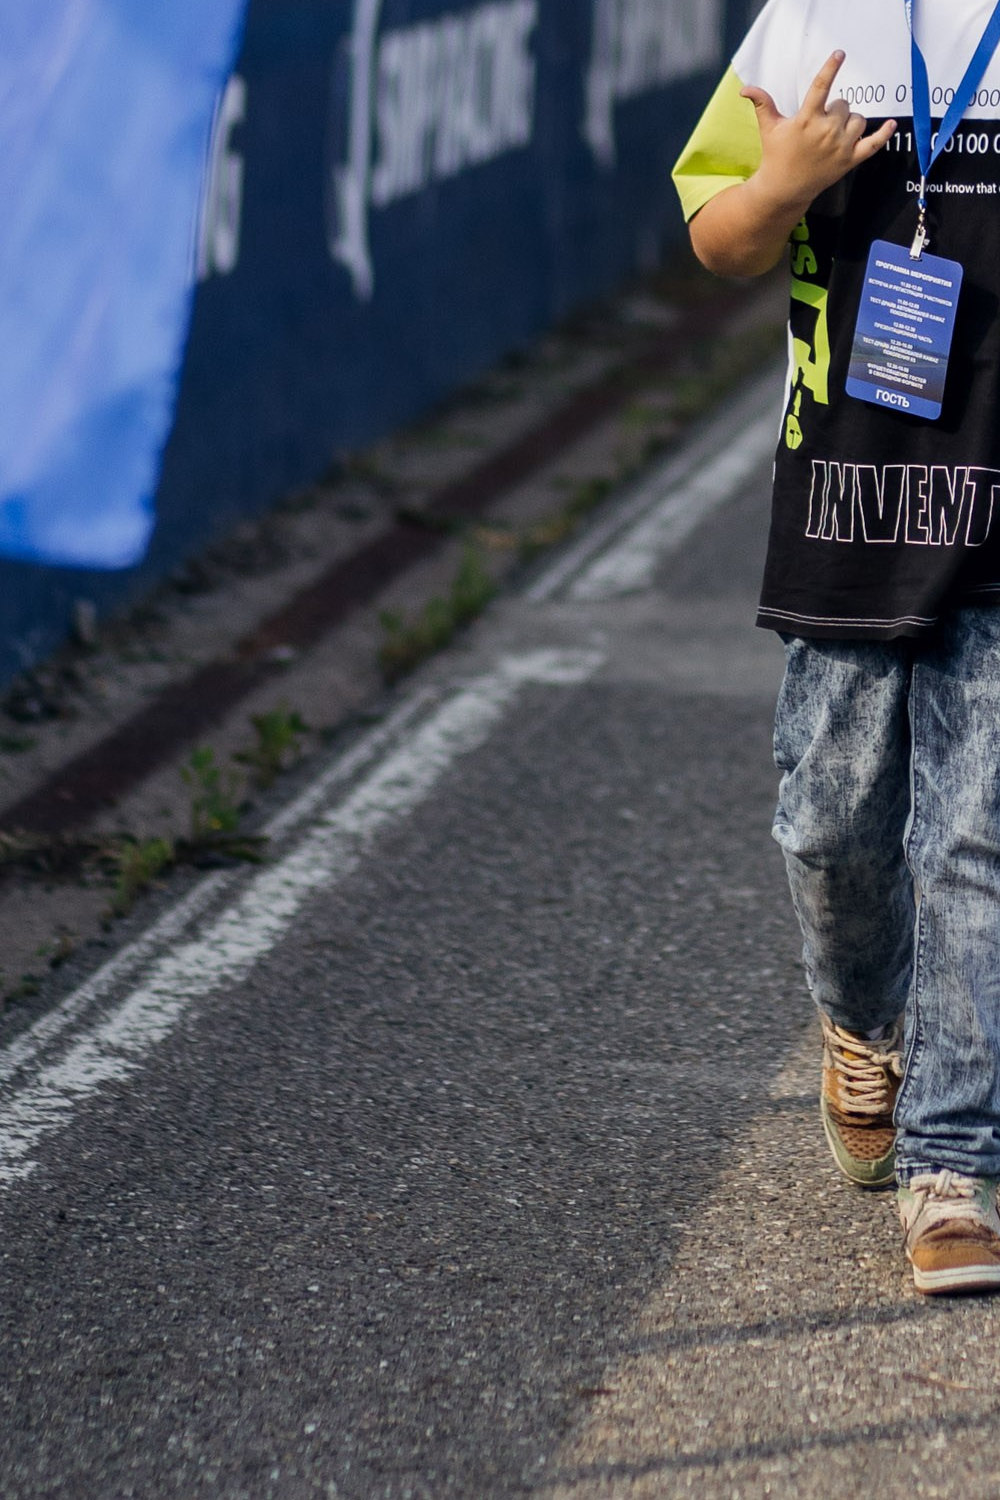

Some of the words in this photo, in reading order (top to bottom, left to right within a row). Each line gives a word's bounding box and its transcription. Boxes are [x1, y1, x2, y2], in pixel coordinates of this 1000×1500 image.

[945, 181, 975, 194] know
[976, 182, 997, 195] that
[876, 390, 911, 408] ГОСТЬ
